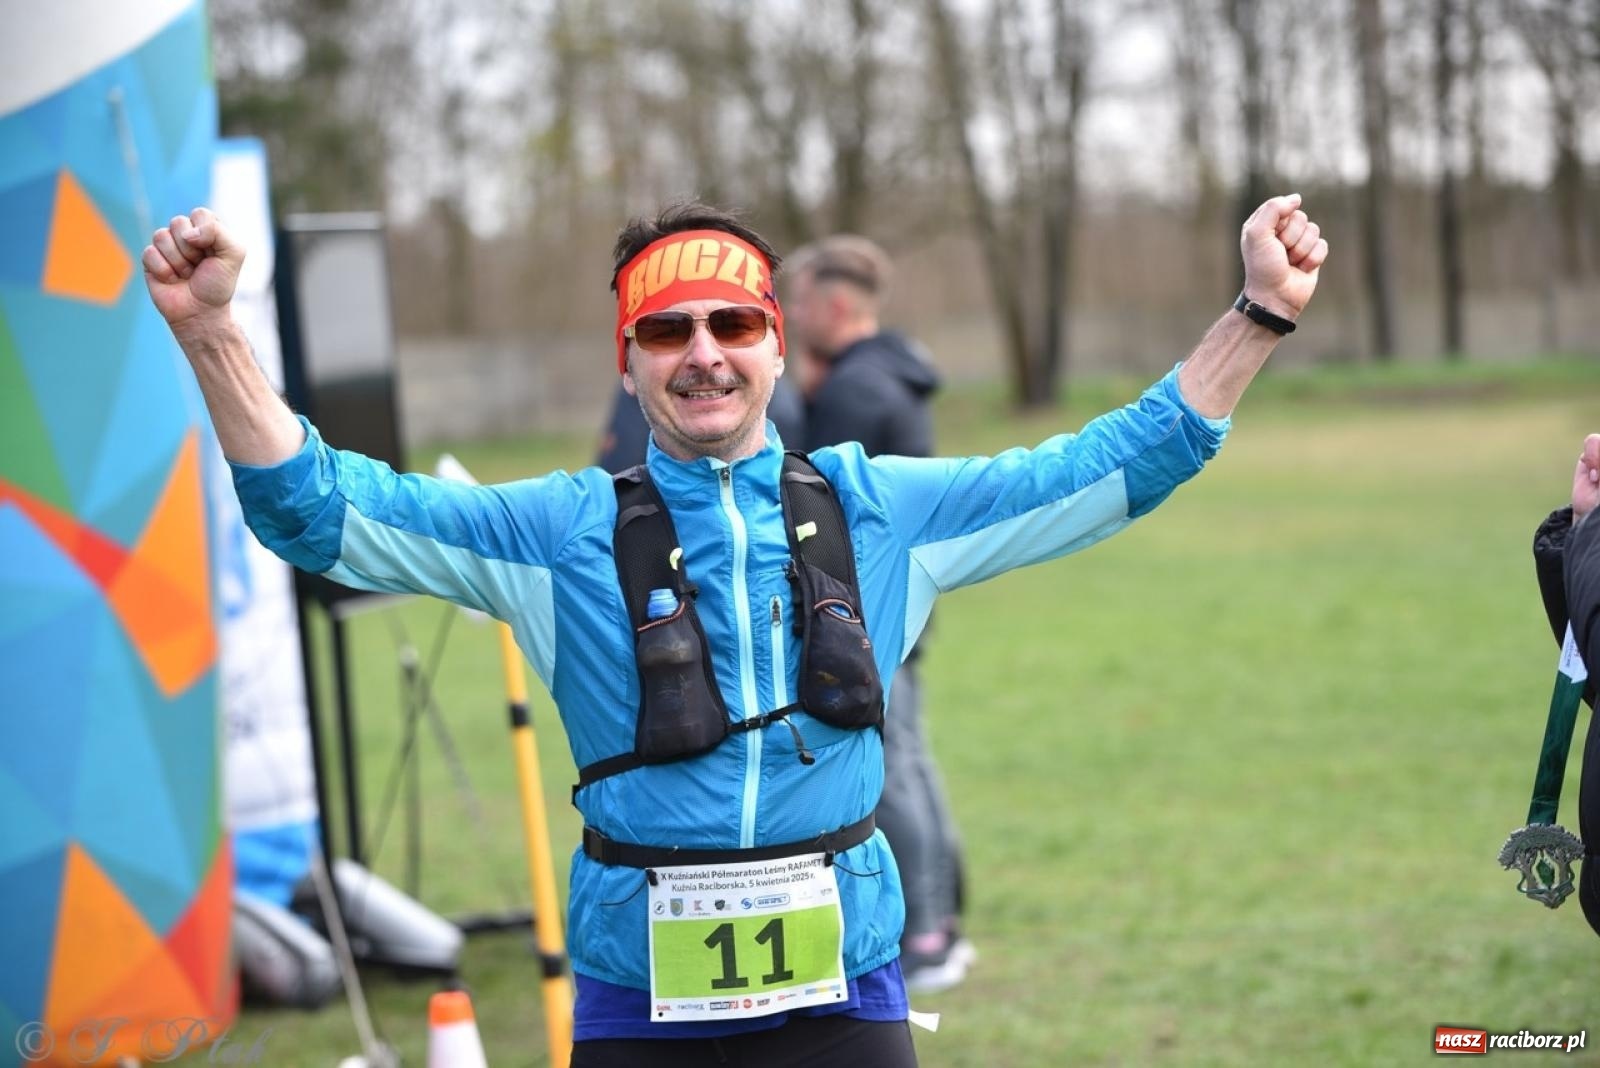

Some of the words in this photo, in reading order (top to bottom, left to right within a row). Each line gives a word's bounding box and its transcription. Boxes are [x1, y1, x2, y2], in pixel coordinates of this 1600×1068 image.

[660, 872, 667, 880] X
[668, 871, 710, 880] Kuźniański
[711, 868, 763, 878] Półmaraton
[764, 864, 787, 874] Leśny
[788, 859, 822, 871] RAFAMET
[671, 883, 697, 892] Kuźnia
[698, 880, 746, 891] Raciborska,
[749, 880, 755, 888] 5
[756, 876, 790, 886] kwietnia
[790, 872, 810, 882] 2025
[703, 917, 794, 990] 11
